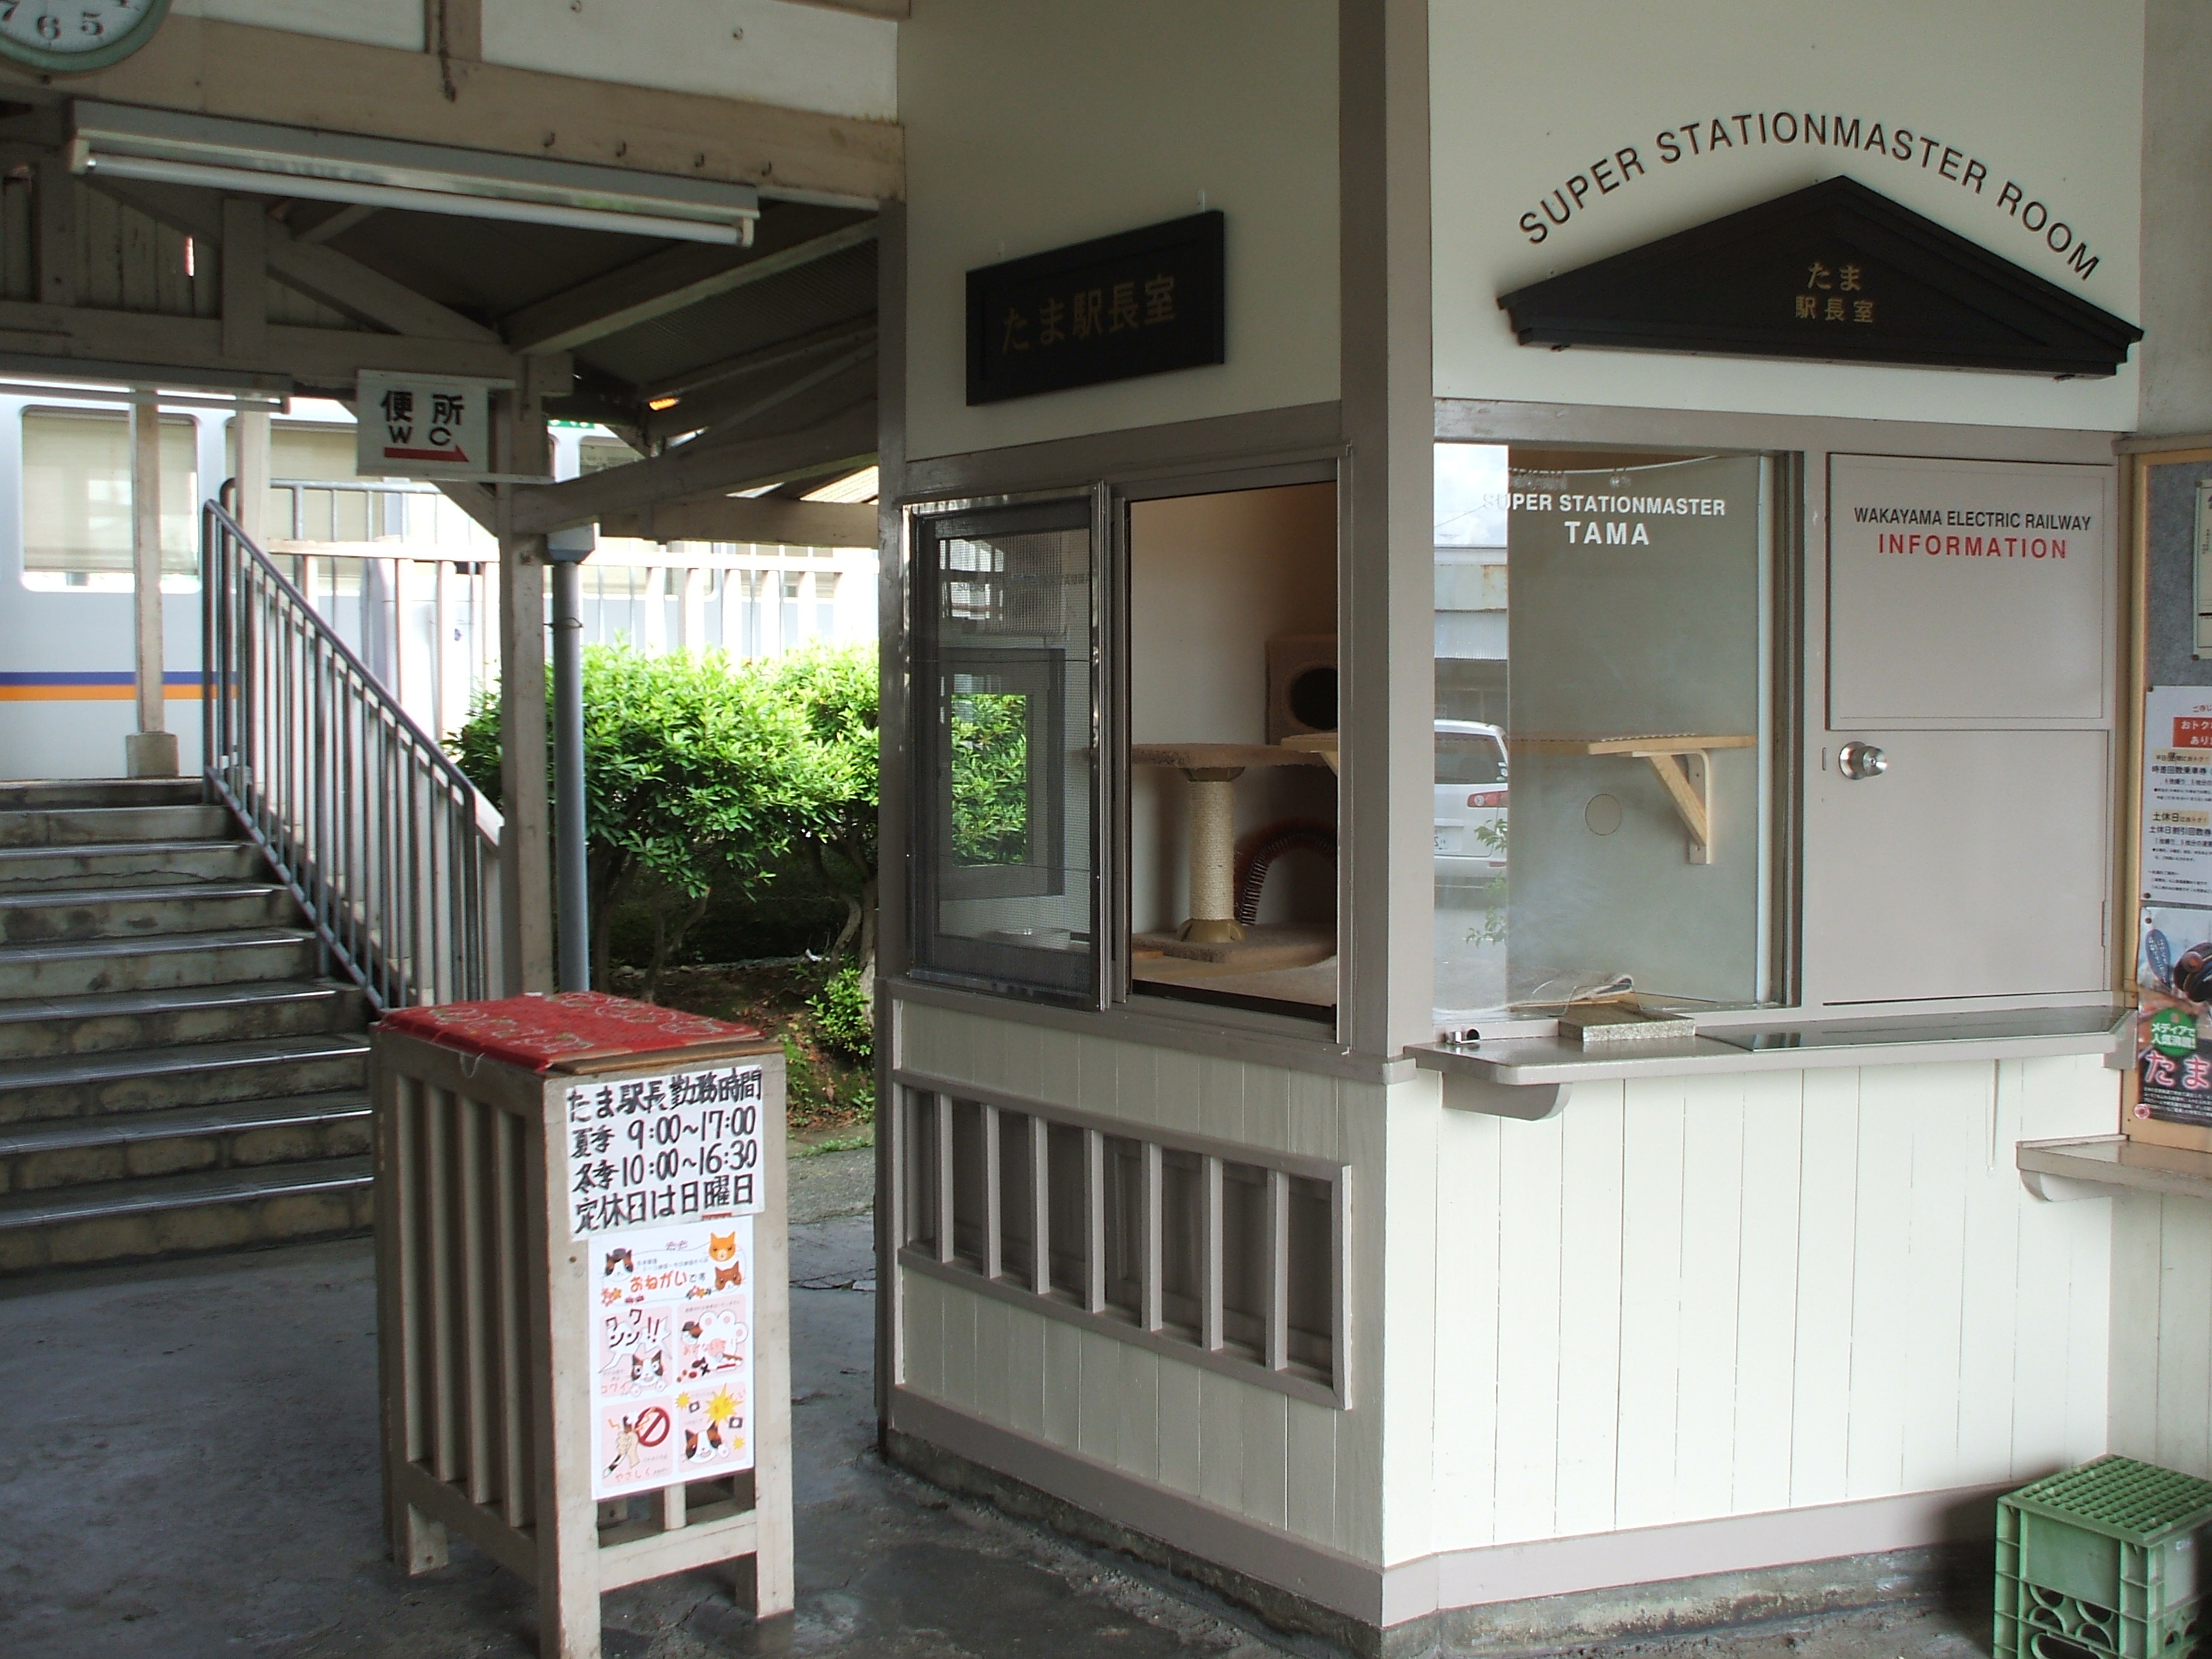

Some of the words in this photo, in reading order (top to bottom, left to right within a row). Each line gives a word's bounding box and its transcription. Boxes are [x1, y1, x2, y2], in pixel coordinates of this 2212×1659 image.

[37, 14, 61, 40] 6
[81, 11, 105, 36] 5
[1518, 147, 1646, 245] SUPER
[1655, 111, 1988, 194] STATIONMASTER
[1995, 180, 2100, 281] ROOM
[1807, 262, 1861, 291] たま
[1002, 273, 1176, 353] たま駅長室
[1795, 295, 1873, 322] 駅長室
[380, 390, 464, 426] 便所
[1483, 492, 1553, 512] SUPER
[1560, 494, 1726, 516] STATIONMASTER
[1854, 506, 1942, 525] WAKAYAMA
[1946, 510, 2021, 528] ELECTRIC
[2025, 513, 2091, 530] RAILWAY
[1563, 520, 1650, 546] TAMA
[1878, 533, 2067, 559] INFORMATION
[566, 1067, 762, 1123] たま駅長勤務時間
[570, 1125, 615, 1159] 夏季
[572, 1159, 619, 1194] 冬季
[574, 1174, 753, 1234] 定休日は日曜日
